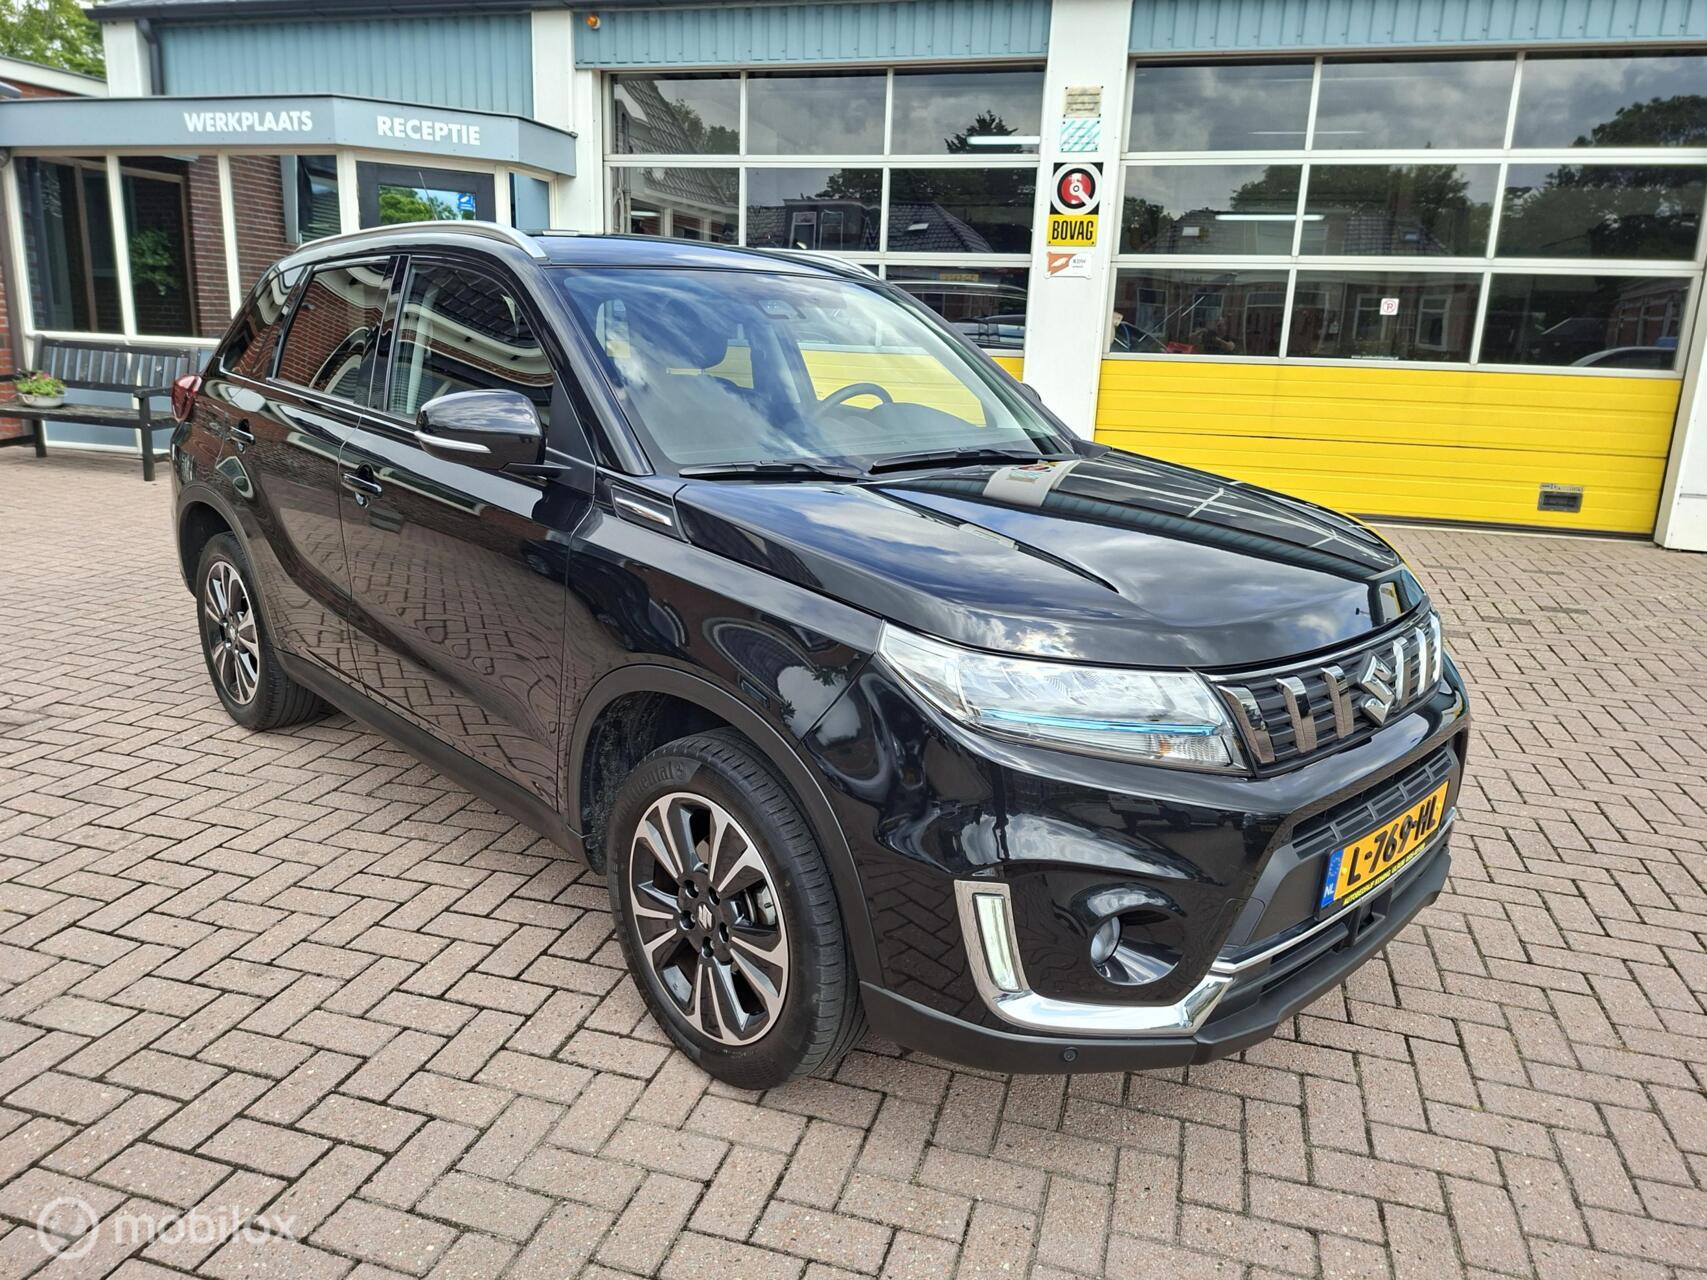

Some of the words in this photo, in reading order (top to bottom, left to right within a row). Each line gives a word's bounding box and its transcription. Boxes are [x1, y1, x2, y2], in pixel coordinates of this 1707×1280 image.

[183, 111, 312, 132] WERKPLAATS
[377, 115, 481, 146] RECEPTIE
[1051, 220, 1094, 241] BOVAG
[1347, 795, 1437, 886] L-769-HL
[1323, 883, 1334, 898] NL
